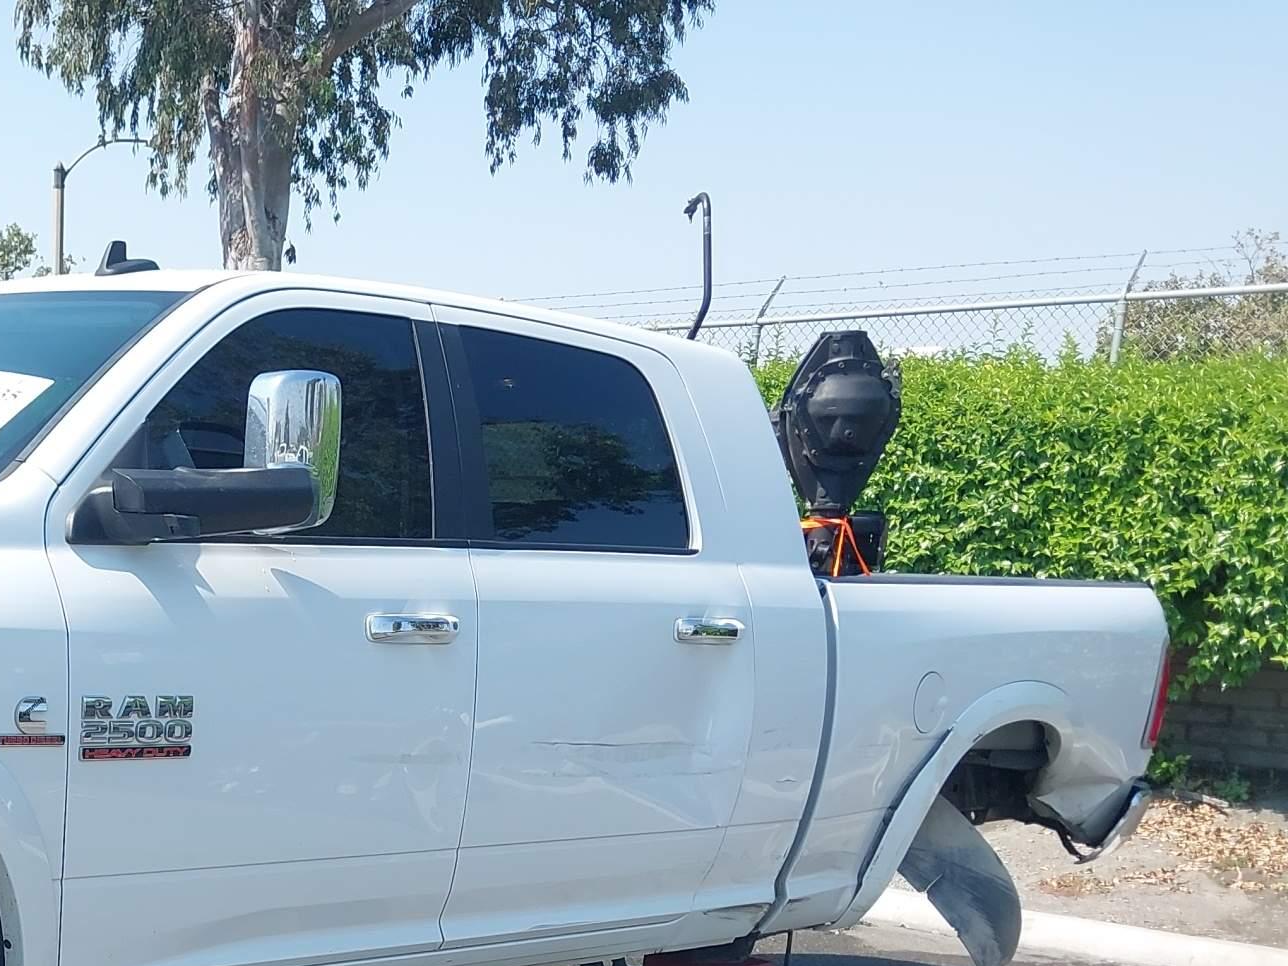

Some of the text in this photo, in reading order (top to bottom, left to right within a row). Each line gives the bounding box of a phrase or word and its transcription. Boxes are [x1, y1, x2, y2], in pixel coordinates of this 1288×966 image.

[81, 695, 194, 720] RAM
[80, 719, 193, 745] 2500
[85, 747, 189, 758] HEAVY DUTY
